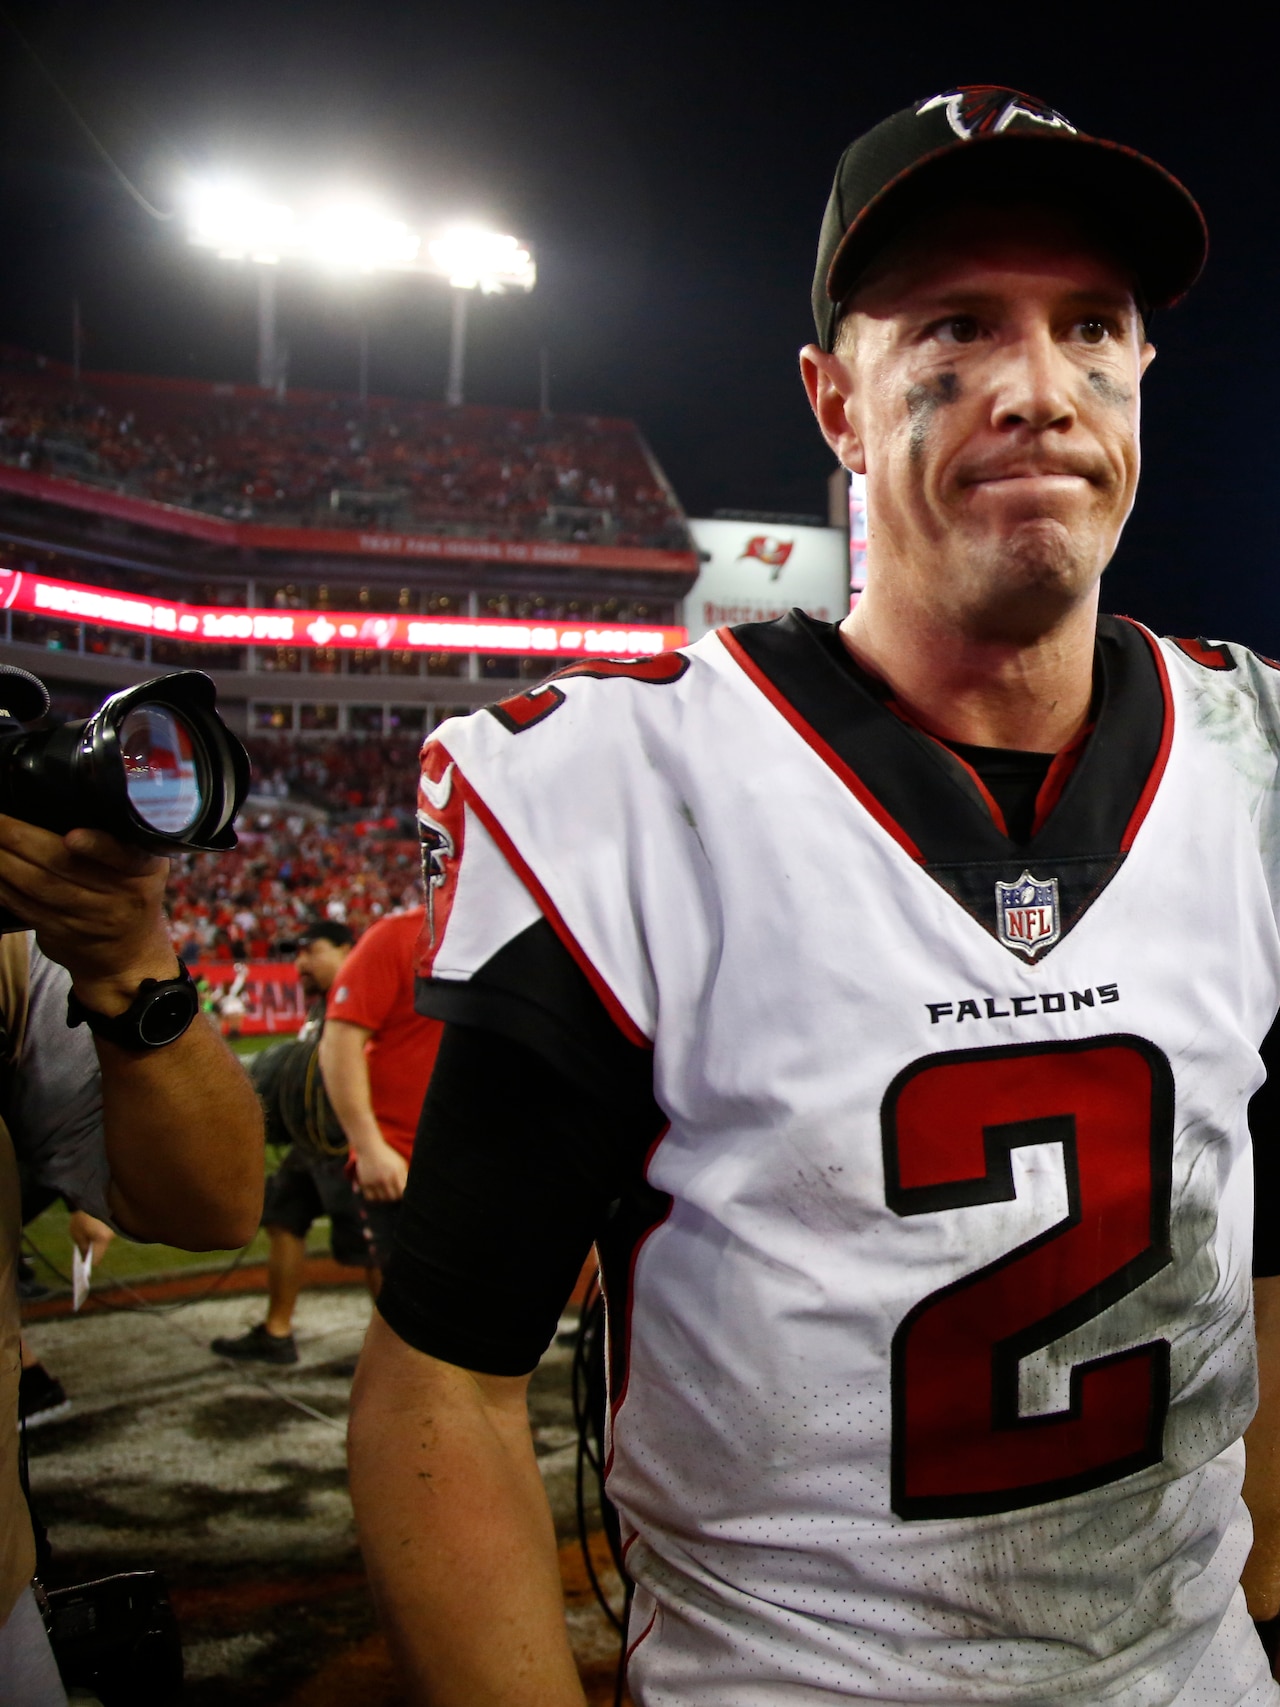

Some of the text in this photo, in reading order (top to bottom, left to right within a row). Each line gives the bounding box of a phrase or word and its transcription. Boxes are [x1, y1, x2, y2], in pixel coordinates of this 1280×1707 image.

[1006, 908, 1050, 940] NFL
[925, 983, 1120, 1024] FALCONS
[880, 1033, 1176, 1521] 2
